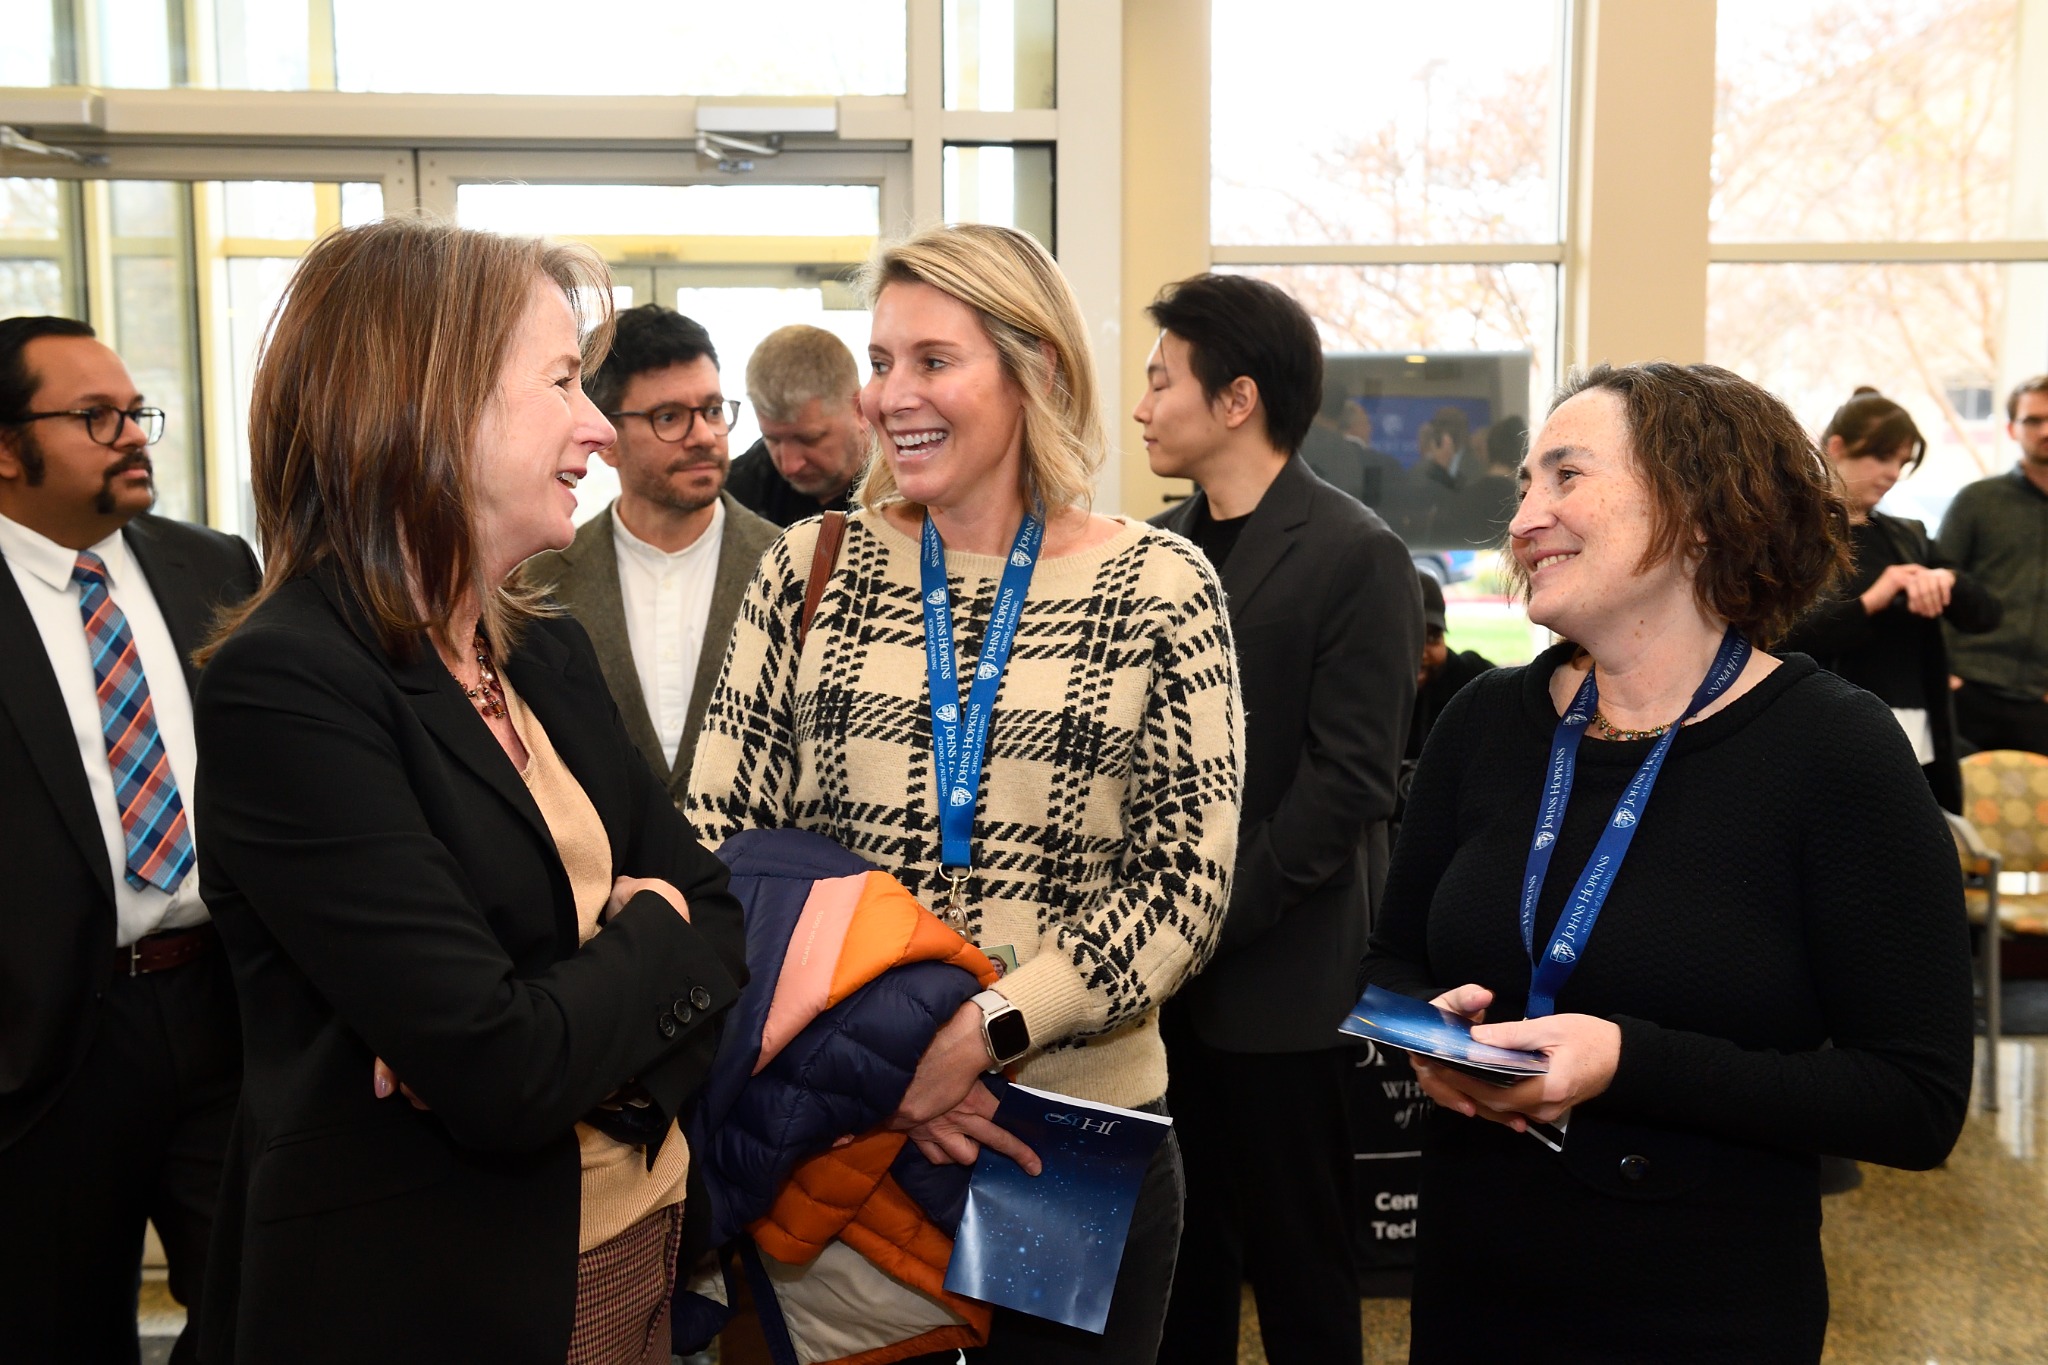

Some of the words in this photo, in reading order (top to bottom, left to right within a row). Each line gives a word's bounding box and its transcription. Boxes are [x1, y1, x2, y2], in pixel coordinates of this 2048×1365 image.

[1017, 519, 1035, 552] JOHNS
[933, 606, 947, 636] JOHNS
[984, 630, 1002, 662] JOHNS
[993, 587, 1014, 629] HOPKINS
[1000, 630, 1011, 653] SCHOOL
[1008, 600, 1020, 625] NURSING
[930, 644, 938, 670] NURSING
[938, 637, 951, 680] HOPKINS
[942, 724, 957, 758] JOHNS
[962, 703, 981, 749] HOPKINS
[937, 736, 945, 761] SCHOOL
[971, 750, 980, 775] SCHOOL
[977, 714, 987, 742] NURSING
[940, 768, 948, 797] NURSING
[955, 751, 971, 786] JOHNS
[1549, 747, 1566, 795] HOPKINS
[1624, 773, 1646, 808] JOHNS
[1541, 796, 1558, 829] JOHNS
[1561, 902, 1586, 943] JOHNS
[1577, 854, 1610, 903] HOPKINS
[1581, 907, 1597, 934] SCHOOL
[1596, 870, 1614, 900] NURSING
